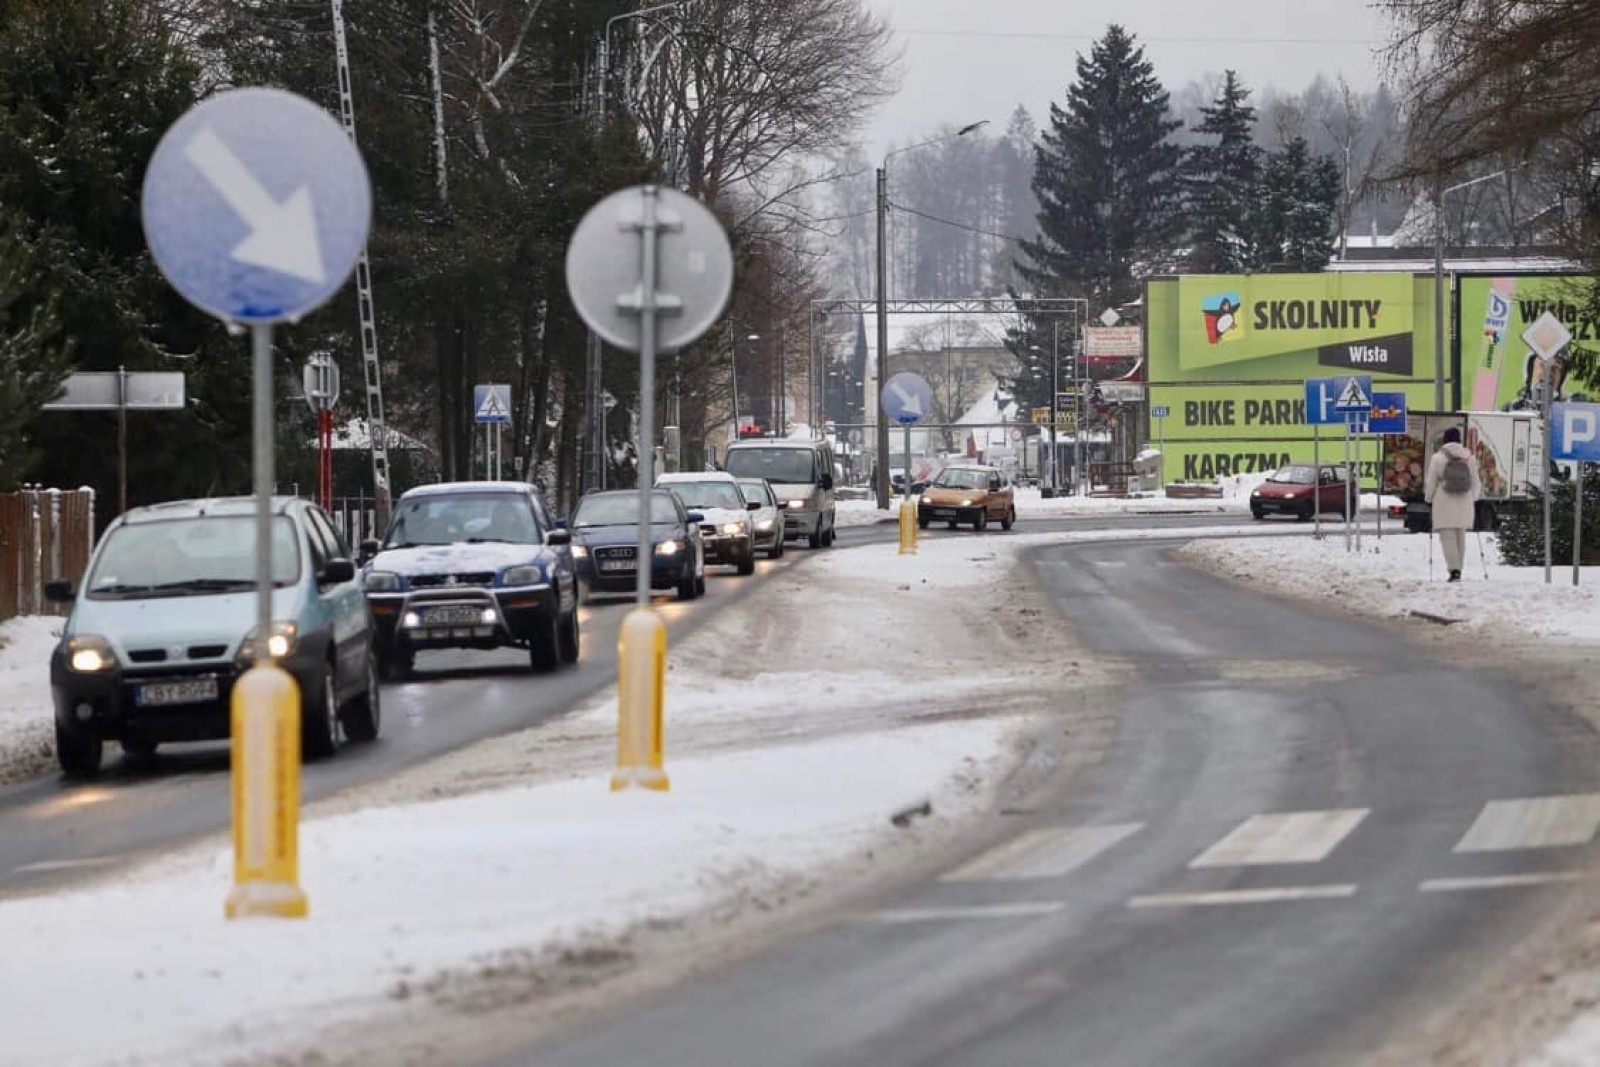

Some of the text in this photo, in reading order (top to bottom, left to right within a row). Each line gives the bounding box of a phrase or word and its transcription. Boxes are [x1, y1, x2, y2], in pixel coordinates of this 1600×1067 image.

[1254, 299, 1381, 330] SKOLNITY
[1350, 346, 1388, 363] Wisła
[1185, 399, 1306, 426] BIKE PARK
[1562, 410, 1596, 454] P
